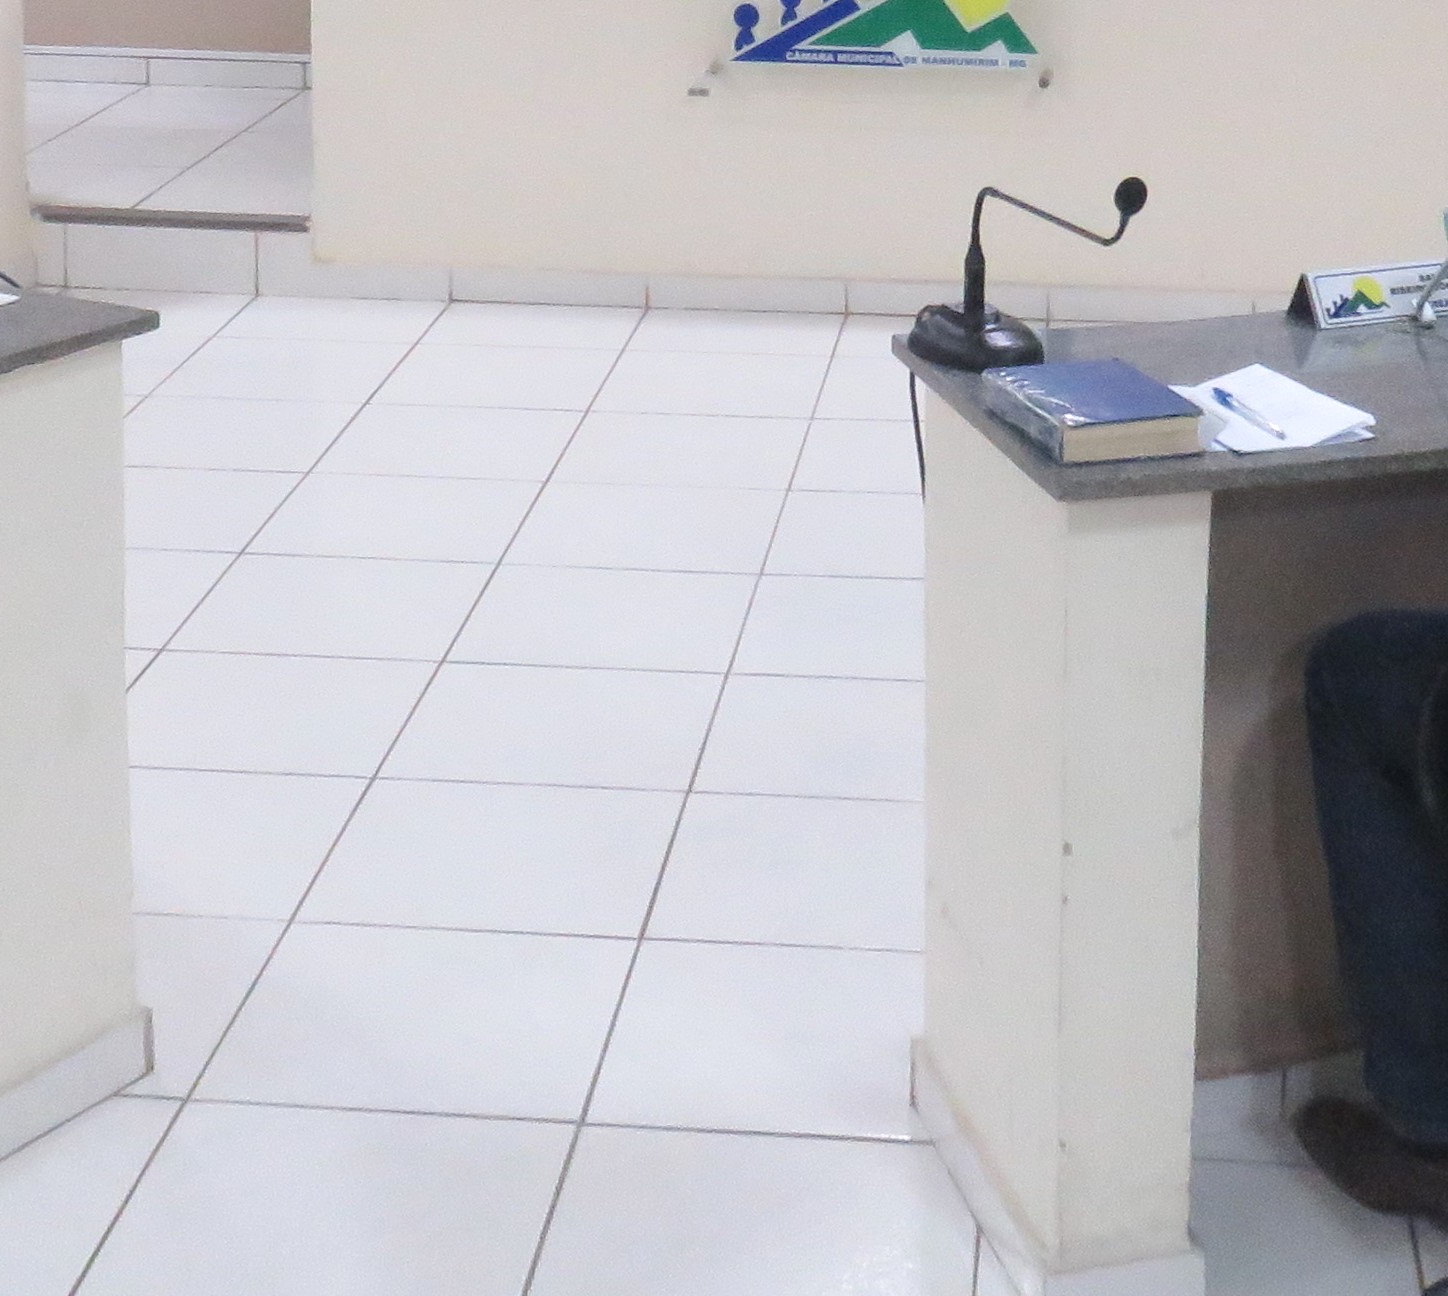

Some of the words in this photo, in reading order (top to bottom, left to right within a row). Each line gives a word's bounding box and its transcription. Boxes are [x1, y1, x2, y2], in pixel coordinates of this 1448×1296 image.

[837, 52, 902, 65] MUNICIPAL
[921, 56, 999, 67] MANHUMIRIM
[1008, 59, 1027, 68] MG
